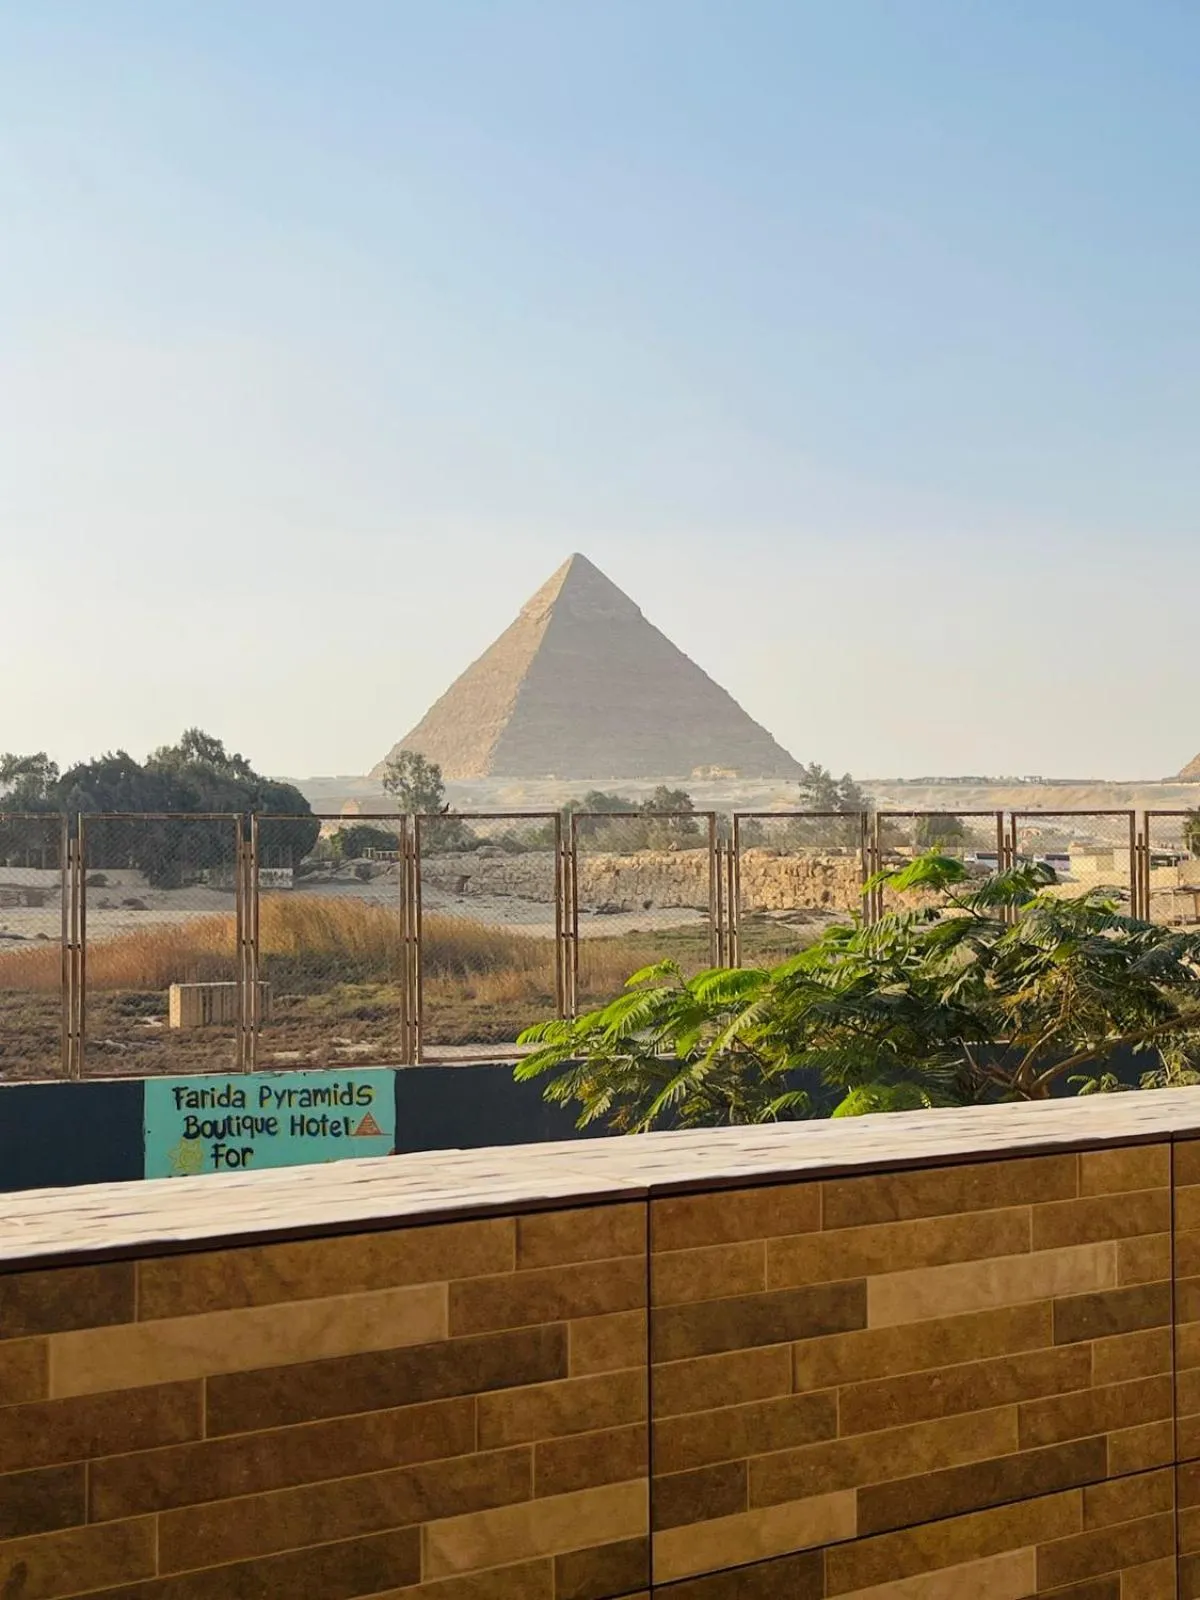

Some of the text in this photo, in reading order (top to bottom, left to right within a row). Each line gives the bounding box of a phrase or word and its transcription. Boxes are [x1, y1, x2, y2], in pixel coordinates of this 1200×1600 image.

[172, 1082, 373, 1110] Farida Pyramids
[183, 1113, 350, 1139] Boutique Hotel
[211, 1143, 254, 1169] For
